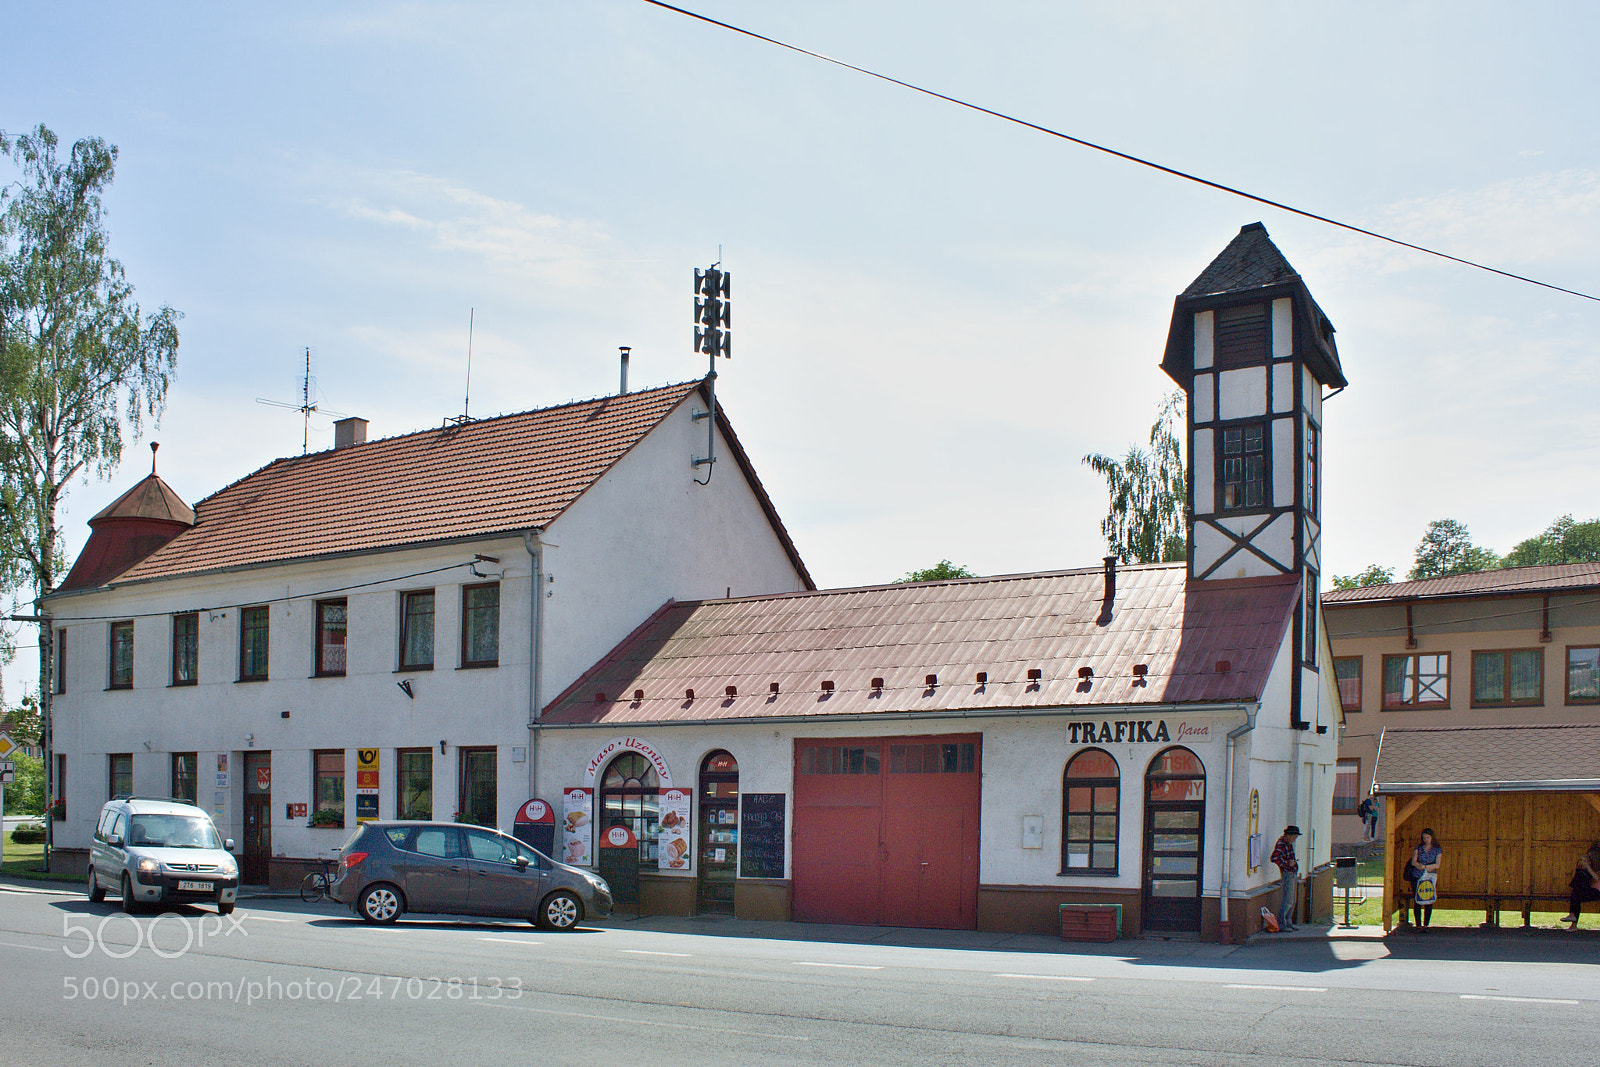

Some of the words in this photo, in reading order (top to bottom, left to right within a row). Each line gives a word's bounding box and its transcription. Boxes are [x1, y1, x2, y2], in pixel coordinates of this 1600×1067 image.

[1067, 720, 1171, 743] TRAFIKA
[1177, 721, 1209, 741] Jana
[588, 743, 615, 776] Maso
[625, 737, 669, 779] Uzeniny
[1162, 756, 1192, 771] TISK
[1152, 782, 1202, 797] NOVINY
